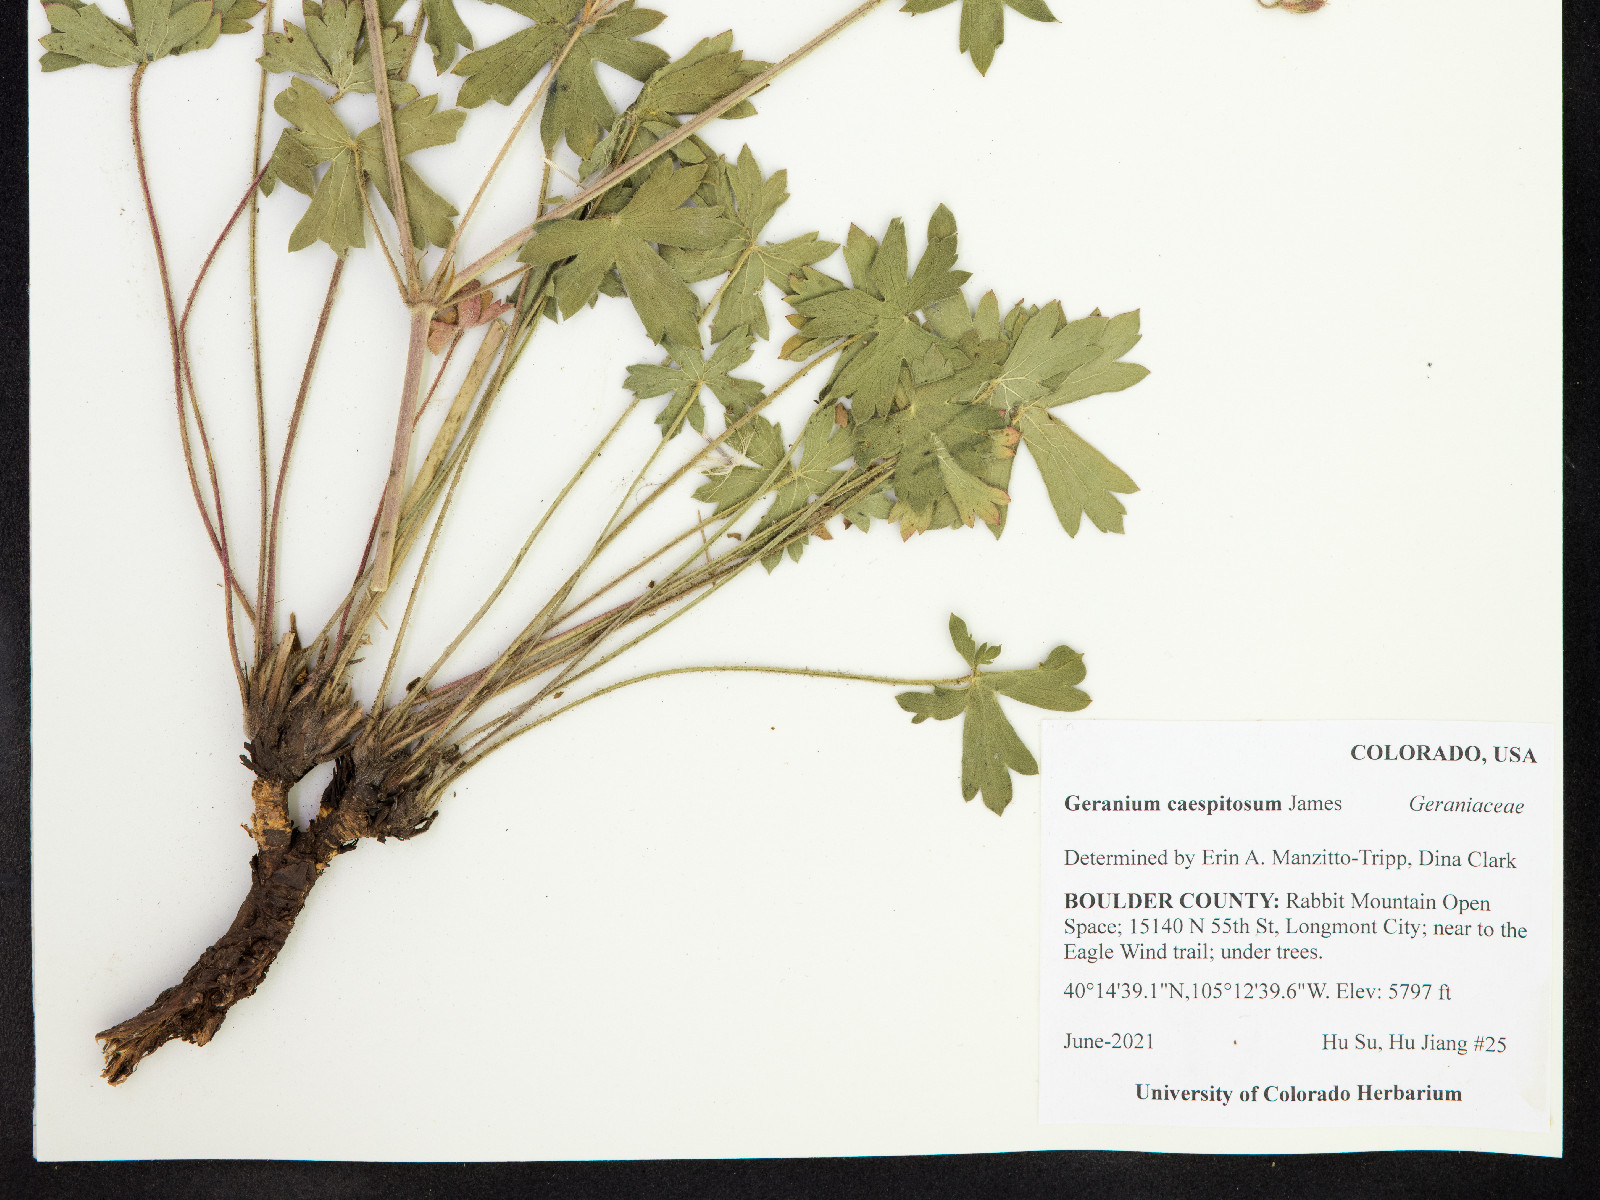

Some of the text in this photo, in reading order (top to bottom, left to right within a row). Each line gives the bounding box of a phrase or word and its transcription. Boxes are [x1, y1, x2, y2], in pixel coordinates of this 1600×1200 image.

[1351, 745, 1537, 764] COLORADO, USA
[1065, 795, 1341, 815] Geranium caespitosum James
[1410, 796, 1524, 814] Geraniaceae
[1064, 849, 1516, 869] Determined by Erin A. Manzitto-Tripp, Dina Clark
[1065, 892, 1491, 914] BOULDER COUNTY: Rabbit Mountain Open
[1065, 918, 1527, 938] Space; 15140 N 55th St, Longmont City; near to the
[1064, 943, 1322, 963] Eagle Wind trail; under trees.
[1337, 983, 1381, 999] Elev:
[1389, 984, 1431, 999] 5797
[1439, 984, 1451, 1000] ft
[1064, 1033, 1153, 1048] June-2021
[1323, 1034, 1506, 1055] Hu Su, Hu Jiang #25
[1136, 1084, 1462, 1106] University of Colorado Herbarium
